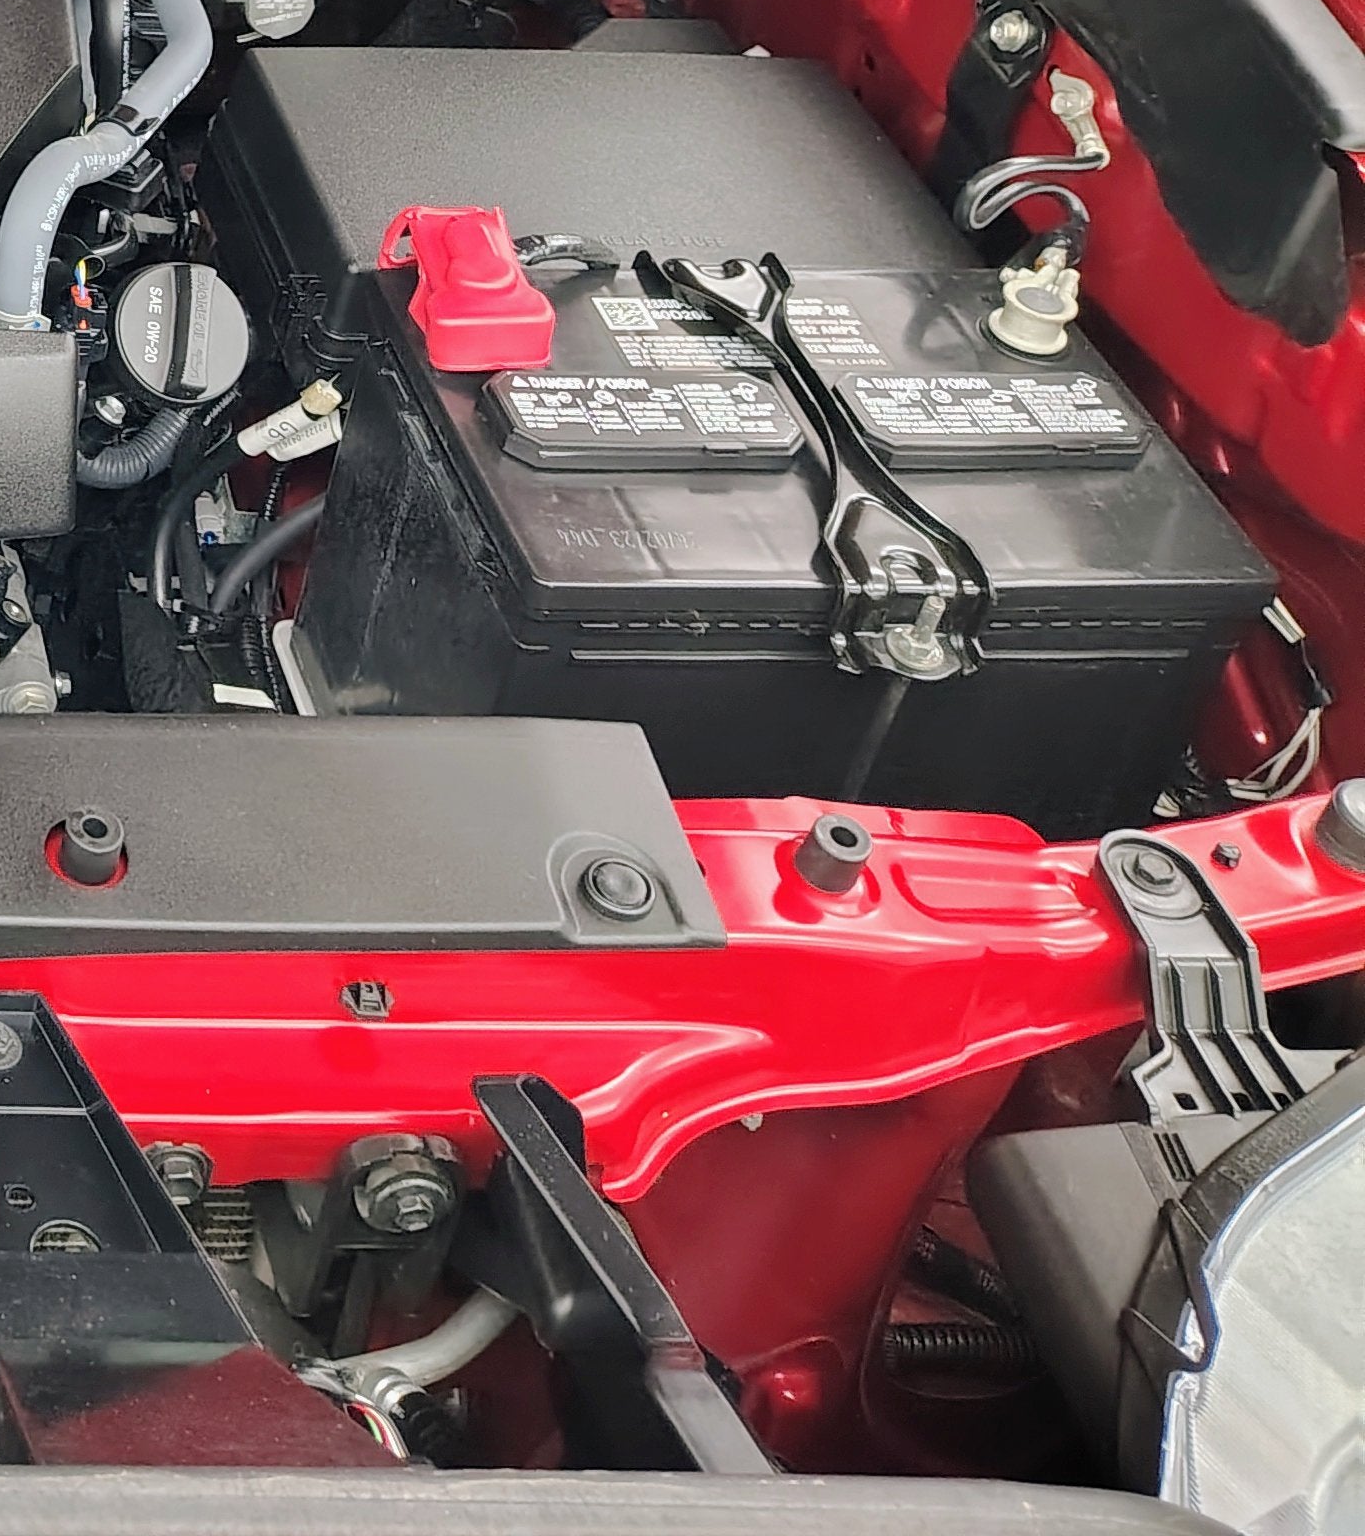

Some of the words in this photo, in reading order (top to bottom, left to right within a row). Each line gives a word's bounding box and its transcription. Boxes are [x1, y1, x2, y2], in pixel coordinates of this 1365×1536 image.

[597, 235, 652, 247] RELAY
[679, 236, 726, 248] FUSE
[149, 286, 163, 315] SAE
[195, 271, 209, 320] ENGINE
[192, 323, 206, 341] OIL
[144, 321, 161, 364] 0W-20
[528, 376, 585, 389] DANGER
[595, 377, 650, 390] POISON
[871, 377, 929, 390] DANGER
[937, 377, 992, 390] POISON
